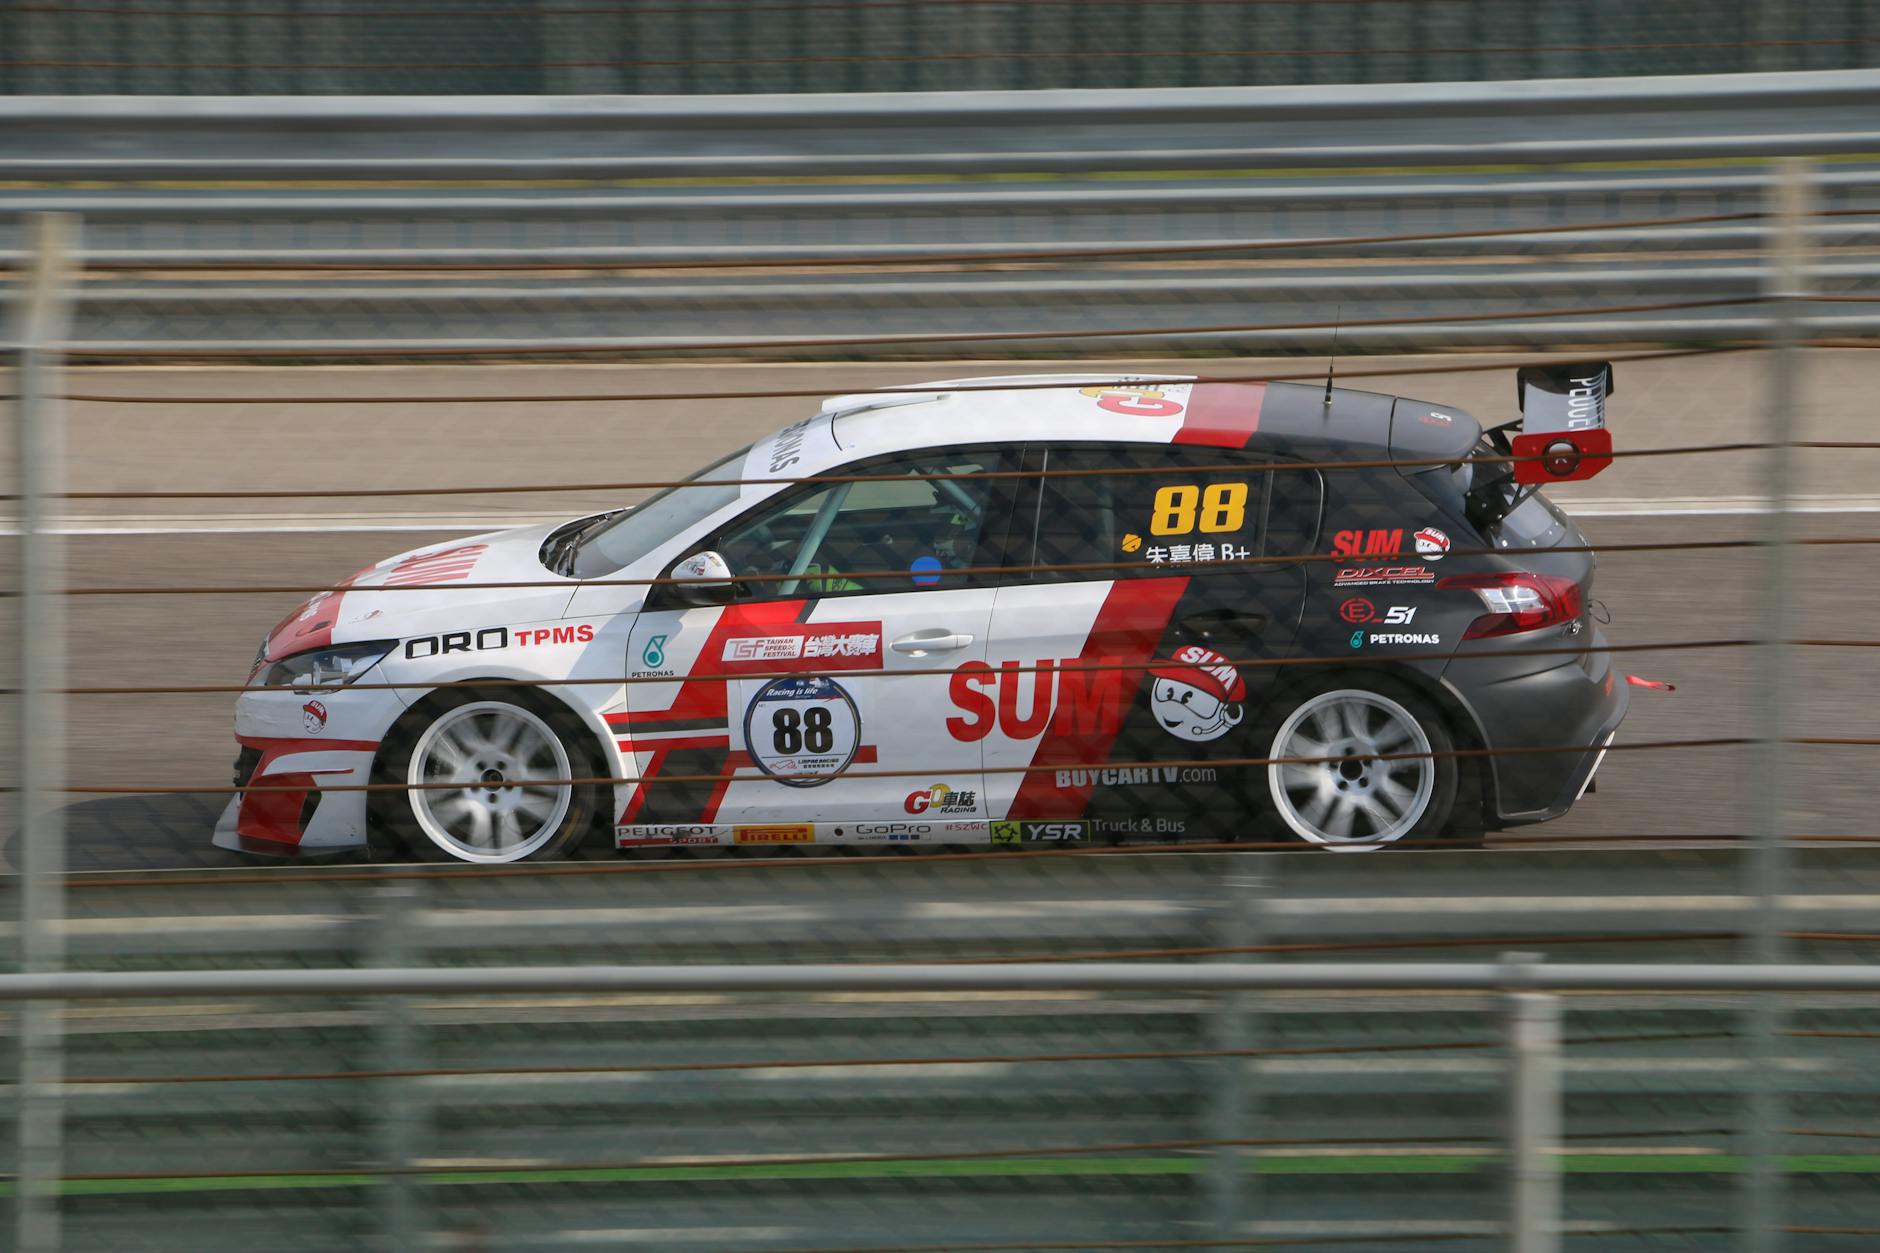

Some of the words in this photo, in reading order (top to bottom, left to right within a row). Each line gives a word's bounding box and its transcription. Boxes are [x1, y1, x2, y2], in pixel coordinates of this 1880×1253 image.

[1150, 482, 1249, 536] 88
[1424, 528, 1445, 544] SUM
[1330, 528, 1404, 563] SUM
[1336, 566, 1435, 579] DIXCEL
[405, 627, 508, 660] ORO
[514, 624, 594, 647] TPMS
[1370, 633, 1440, 644] PETRONAS
[631, 669, 675, 679] PETRONAS
[1180, 646, 1239, 692] SUM
[767, 687, 795, 698] Racing
[796, 687, 803, 695] is
[803, 687, 819, 696] life
[945, 655, 1124, 743] SUM
[310, 701, 326, 716] SUM
[772, 706, 834, 755] 88
[1055, 766, 1217, 788] BUYCARTV.com
[940, 806, 977, 814] RACING
[618, 826, 718, 837] PEUGEOT
[856, 824, 931, 835] GoPro
[1027, 823, 1082, 841] YSR
[1092, 819, 1138, 832] Truck
[1141, 818, 1153, 832] &
[1156, 818, 1186, 833] Bus
[740, 827, 808, 842] PIRELLI
